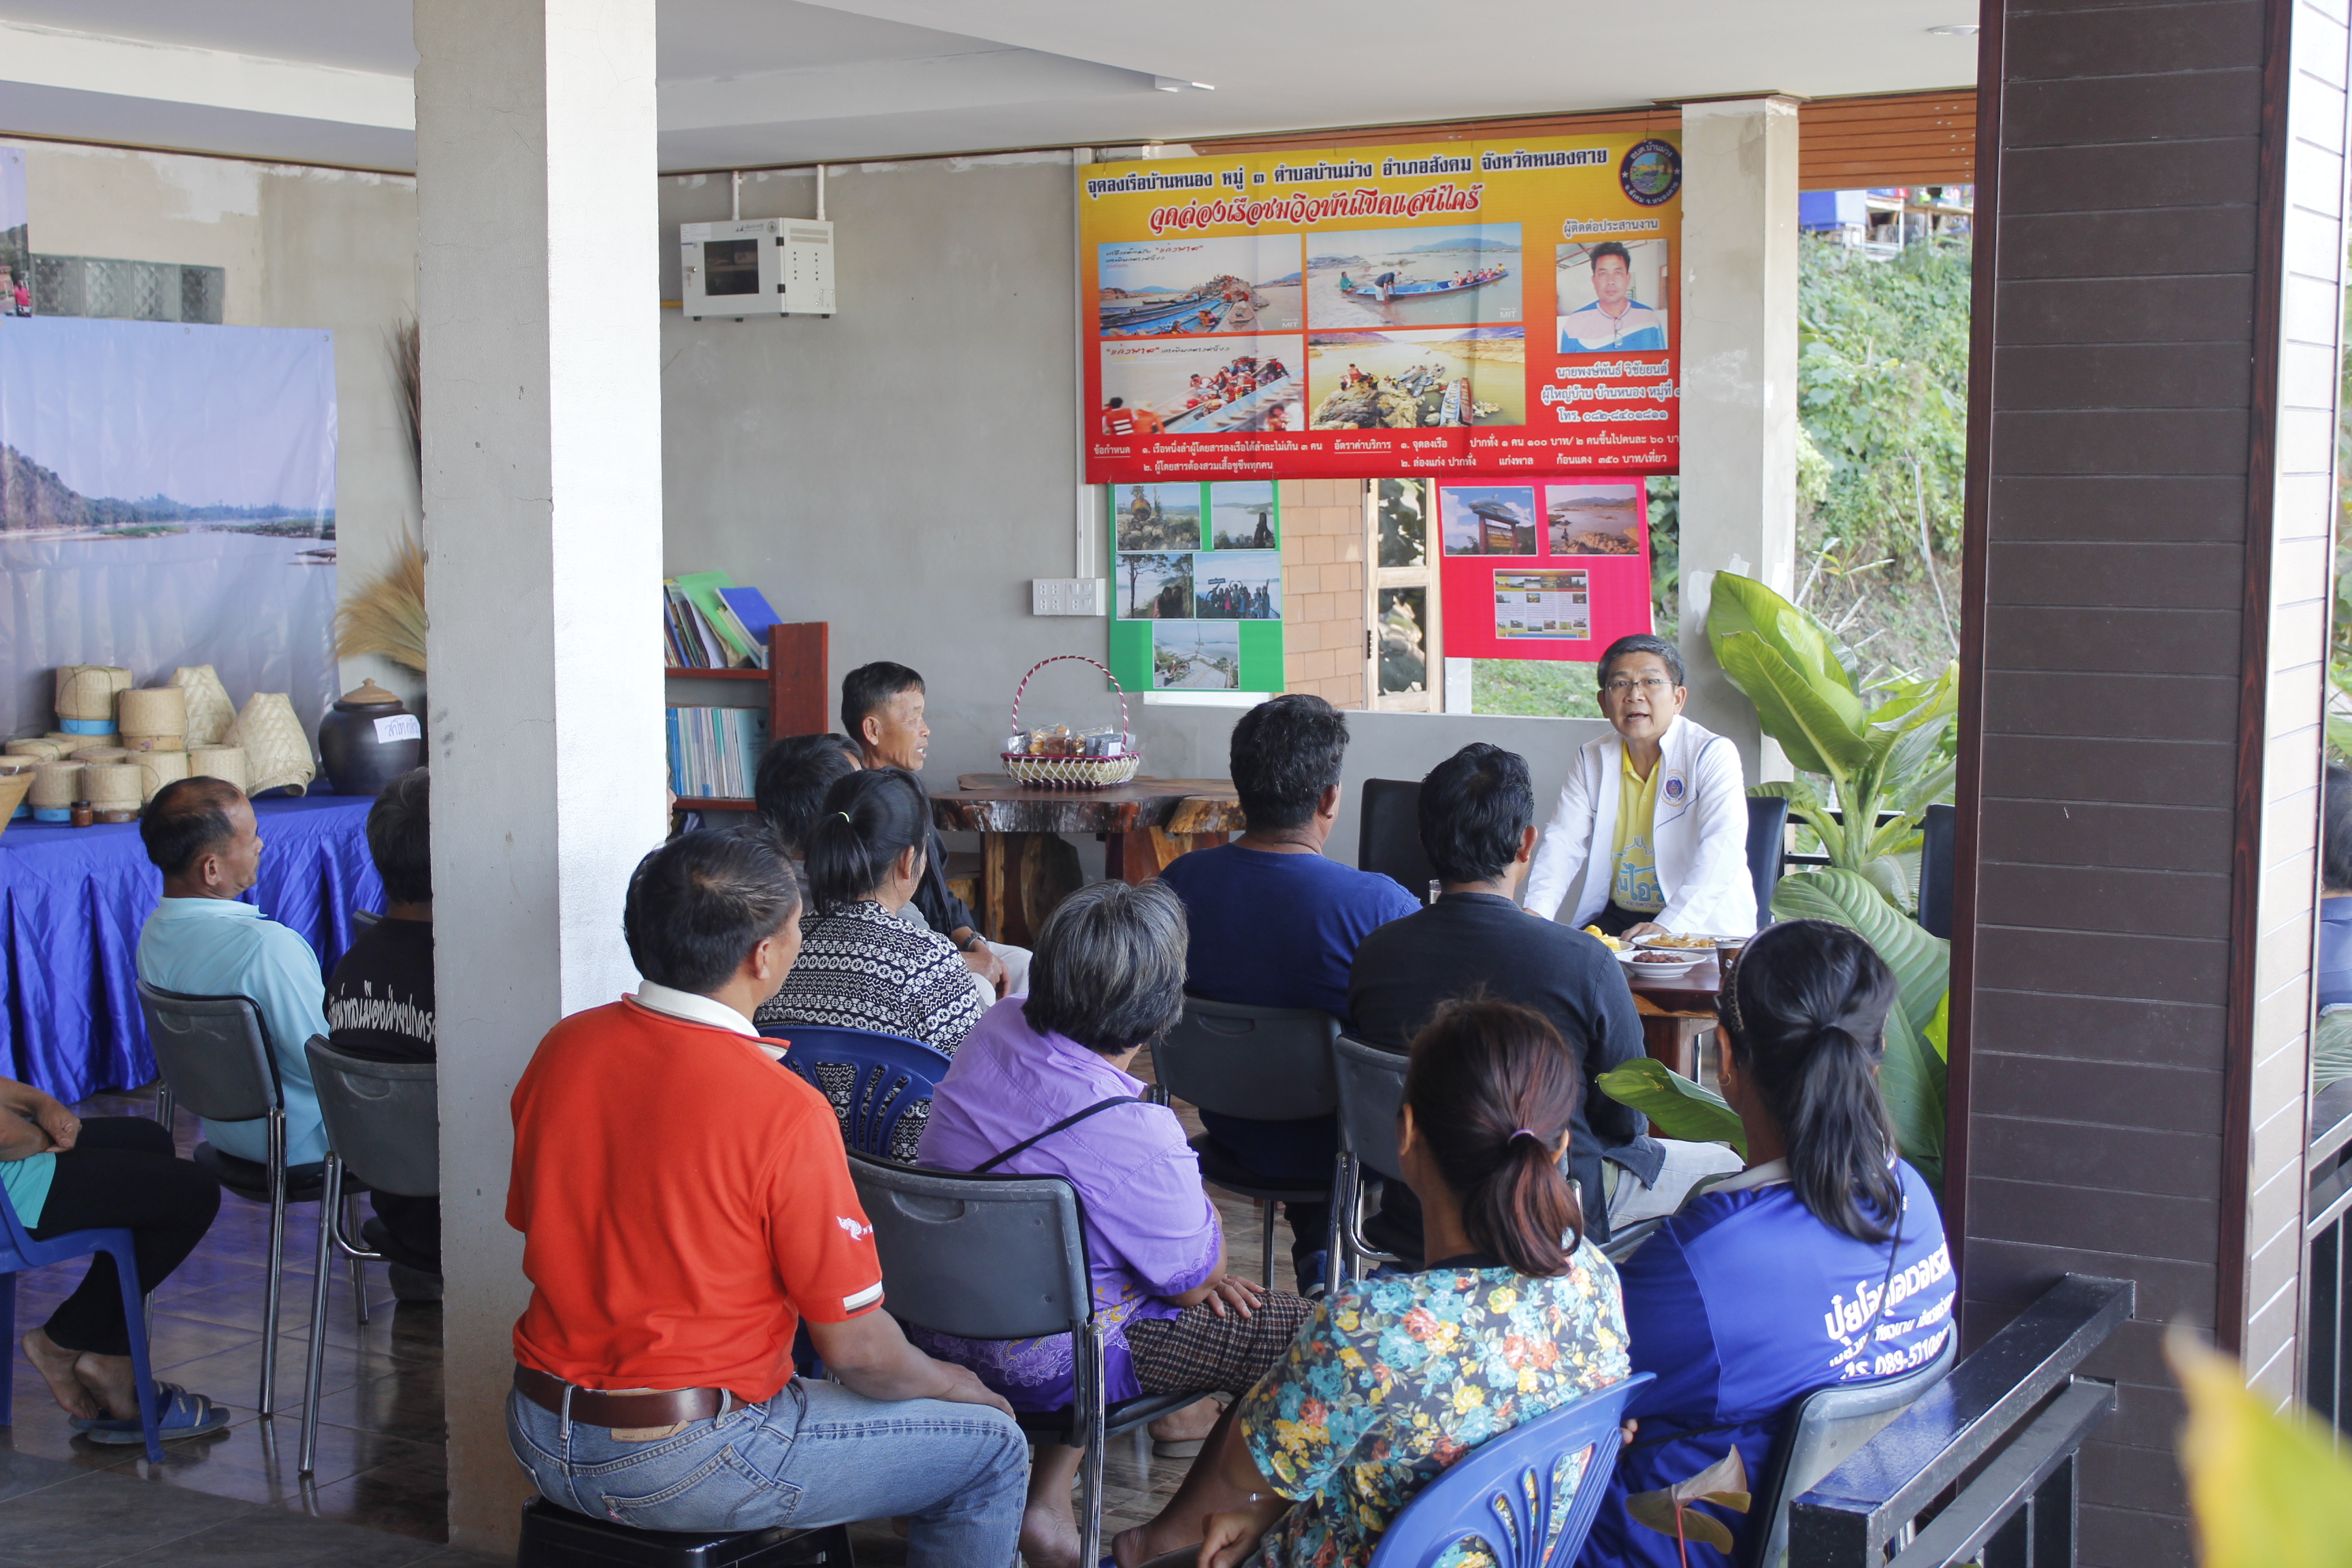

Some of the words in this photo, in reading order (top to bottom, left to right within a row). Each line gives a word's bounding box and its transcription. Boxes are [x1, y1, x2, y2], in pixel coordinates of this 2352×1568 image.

[1088, 172, 1212, 198] จุดลงเรือบ้านหนอง
[1223, 167, 1243, 189] หมู่
[1254, 174, 1264, 183] ๓
[1275, 161, 1373, 182] ตำบลบ้านม่วง
[1383, 156, 1471, 176] อำเภอสังคม
[1482, 148, 1607, 172] จังหวัดหนองคาย
[1564, 219, 1659, 237] ผู้ติดต่อประสานงาน
[1543, 386, 1592, 403] ผู้ใหญ่บ้าน
[1595, 384, 1645, 398] บ้านหนอง
[1648, 380, 1671, 400] หมู่ที่
[1558, 408, 1580, 421] โทร.
[1094, 444, 1130, 455] ข้อกำหนด
[1310, 442, 1322, 451] คน
[1334, 439, 1391, 450] อัตราค่าบริการ
[1412, 437, 1448, 451] จุดลงเรือ
[1511, 438, 1524, 446] คน
[1667, 434, 1679, 444] บา
[1413, 456, 1445, 467] ล่องแก่ง
